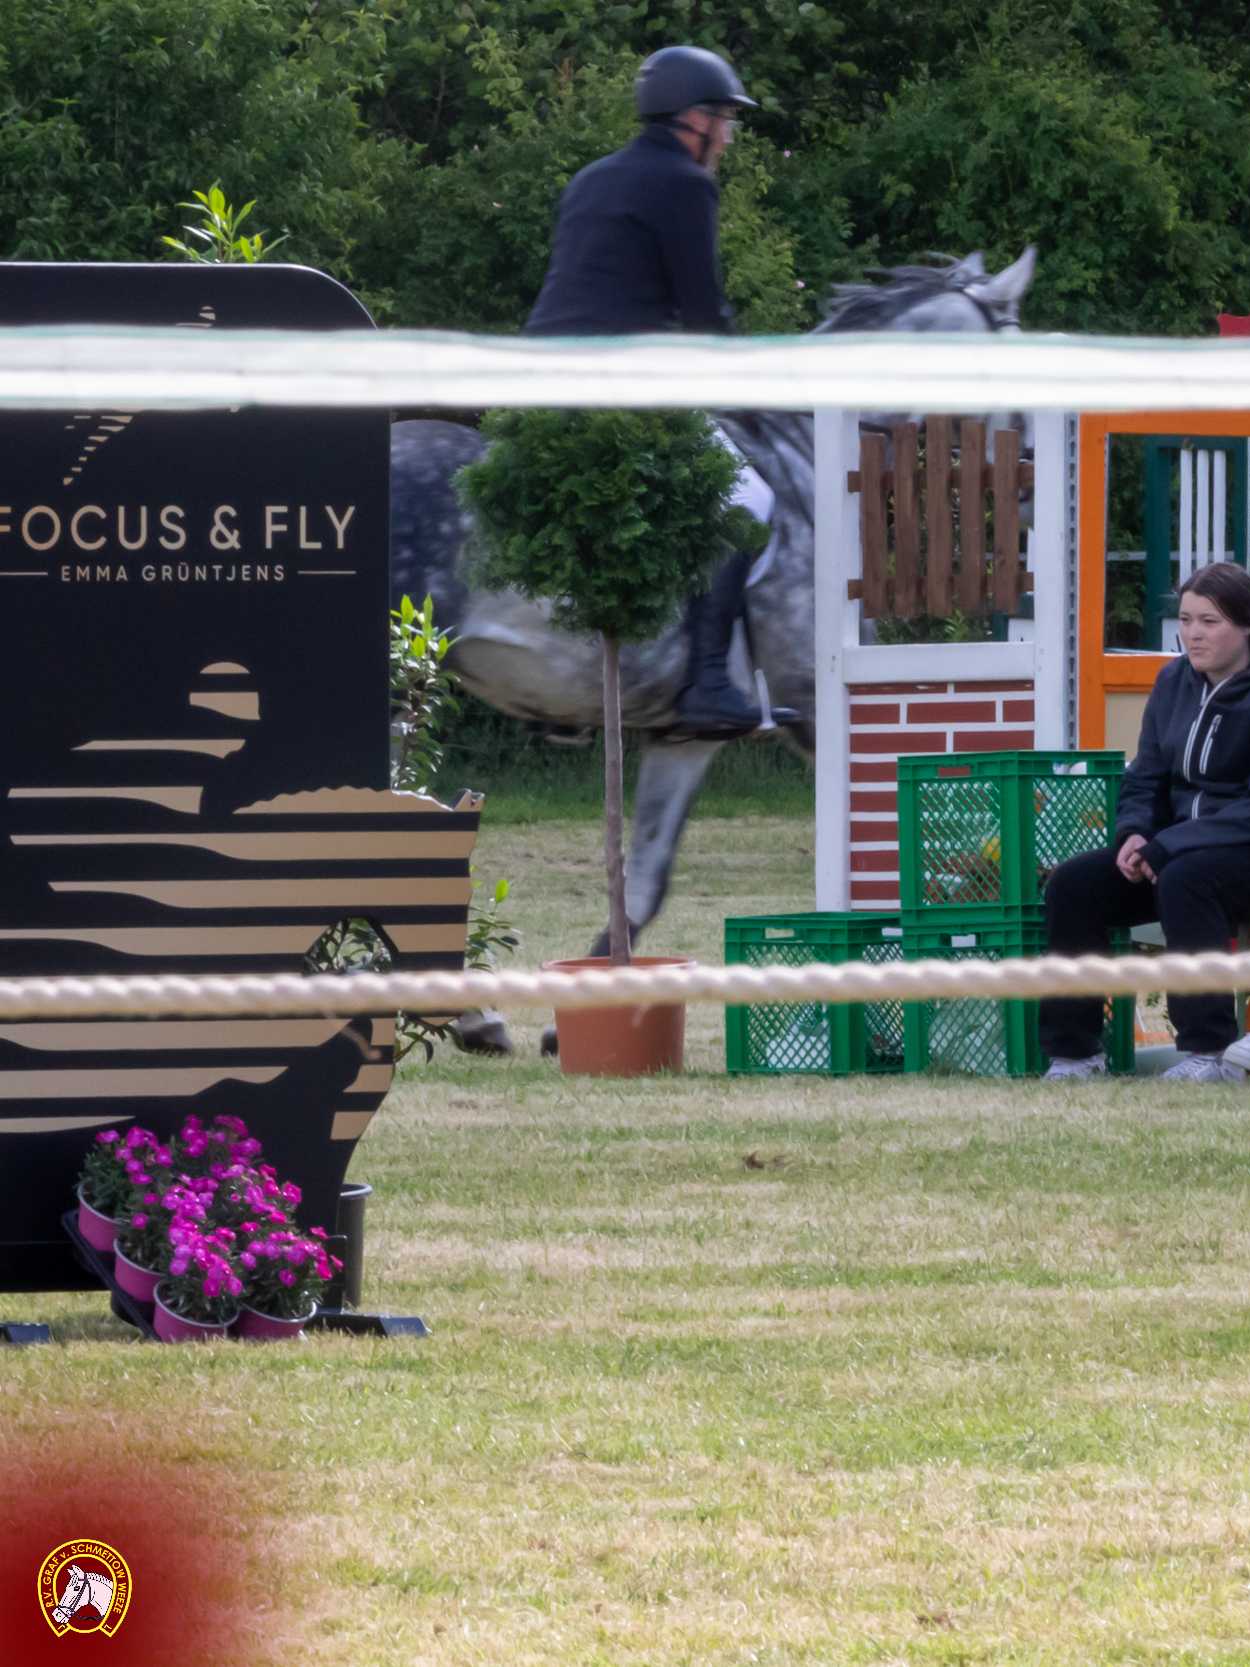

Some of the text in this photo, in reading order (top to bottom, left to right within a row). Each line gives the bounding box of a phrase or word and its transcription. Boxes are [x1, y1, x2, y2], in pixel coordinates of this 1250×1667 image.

[209, 504, 241, 550] &
[265, 505, 356, 550] FLY
[61, 562, 285, 582] EMMA GRÜNTJENS
